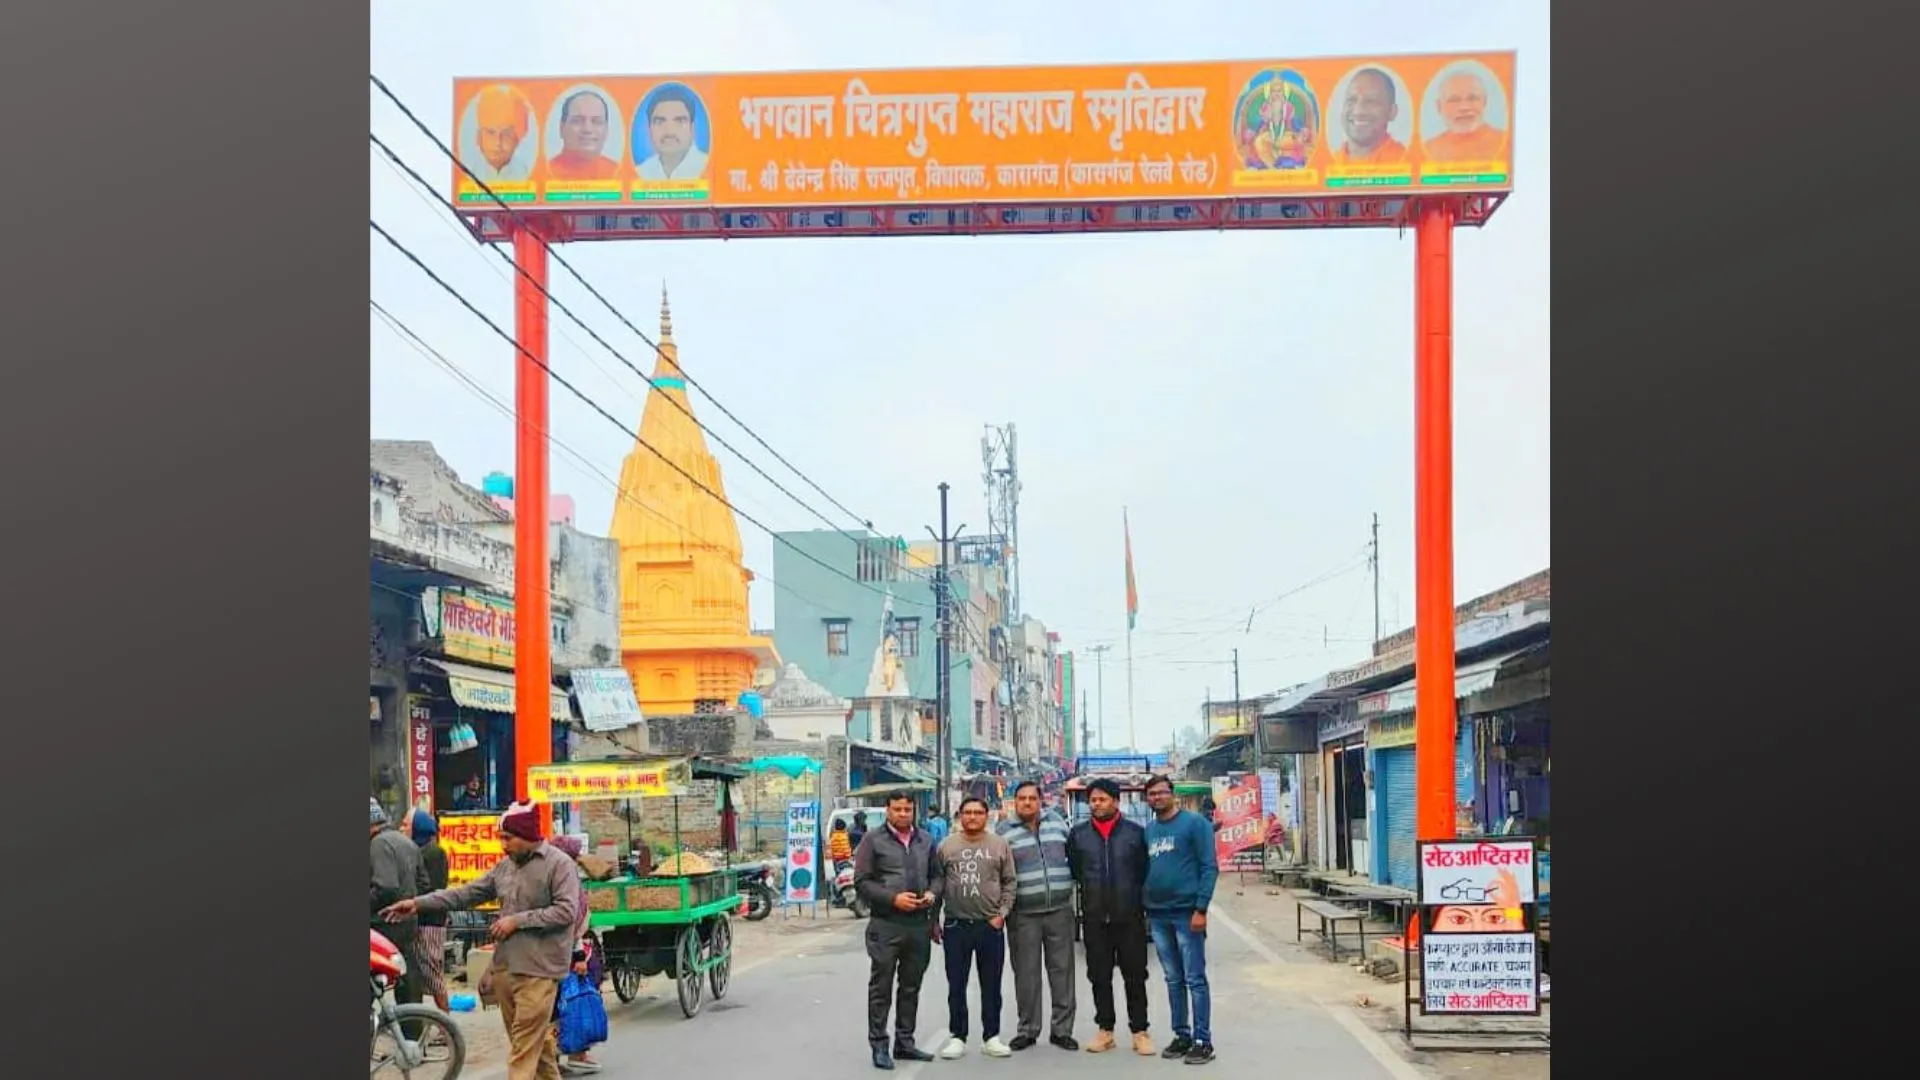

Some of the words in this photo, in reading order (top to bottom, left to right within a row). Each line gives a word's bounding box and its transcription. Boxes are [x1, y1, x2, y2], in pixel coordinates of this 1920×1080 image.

[739, 95, 835, 139] भगवान
[843, 77, 960, 157] चित्रगुप्त
[967, 90, 1075, 139] महाराज
[1083, 72, 1206, 151] स्मृतिद्वार
[760, 159, 779, 191] श्री
[783, 160, 825, 192] देवेन्द्र
[830, 158, 860, 190] सिंह
[1139, 153, 1173, 185] रेलवे
[444, 600, 496, 638] माहेश्वरी
[961, 848, 992, 860] CAL
[960, 872, 980, 884] RN
[963, 884, 980, 896] IA
[1450, 961, 1499, 972] ACCURATE
